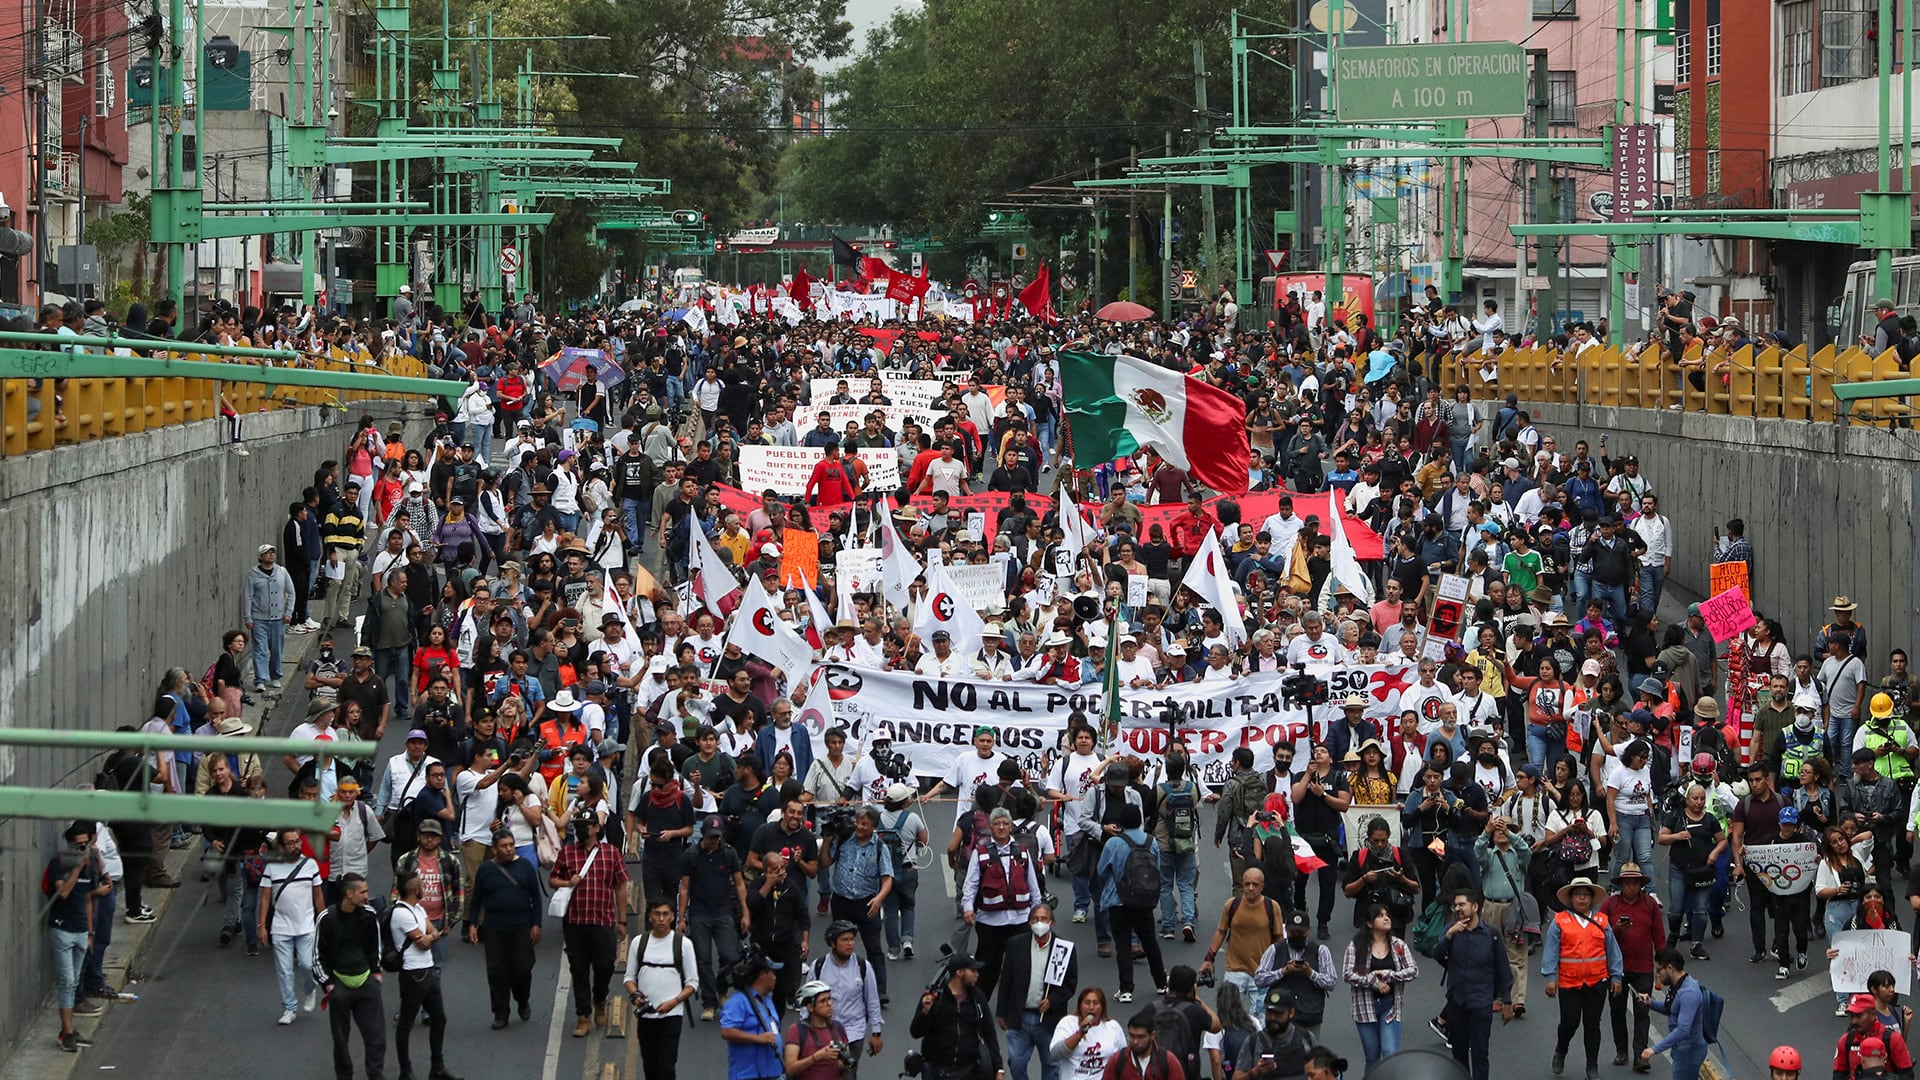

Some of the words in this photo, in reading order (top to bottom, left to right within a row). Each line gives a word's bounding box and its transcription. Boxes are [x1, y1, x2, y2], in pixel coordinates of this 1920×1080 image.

[1342, 54, 1420, 80] SEMAFOROS
[1425, 56, 1442, 77] EN
[1391, 87, 1404, 109] A
[1413, 86, 1446, 108] 100
[1457, 88, 1474, 106] m
[1618, 126, 1631, 214] VERIFICENTRO
[1637, 129, 1647, 193] ENTRADA
[765, 450, 808, 460] PUEBLO
[766, 461, 816, 471] QUEREMO
[1719, 562, 1741, 576] RICO
[1710, 574, 1750, 593] TEPACHE
[1330, 670, 1369, 691] 50
[847, 702, 858, 713] 68
[912, 680, 978, 712] NO
[987, 690, 1033, 714] AL
[1240, 715, 1401, 750] POPUAR
